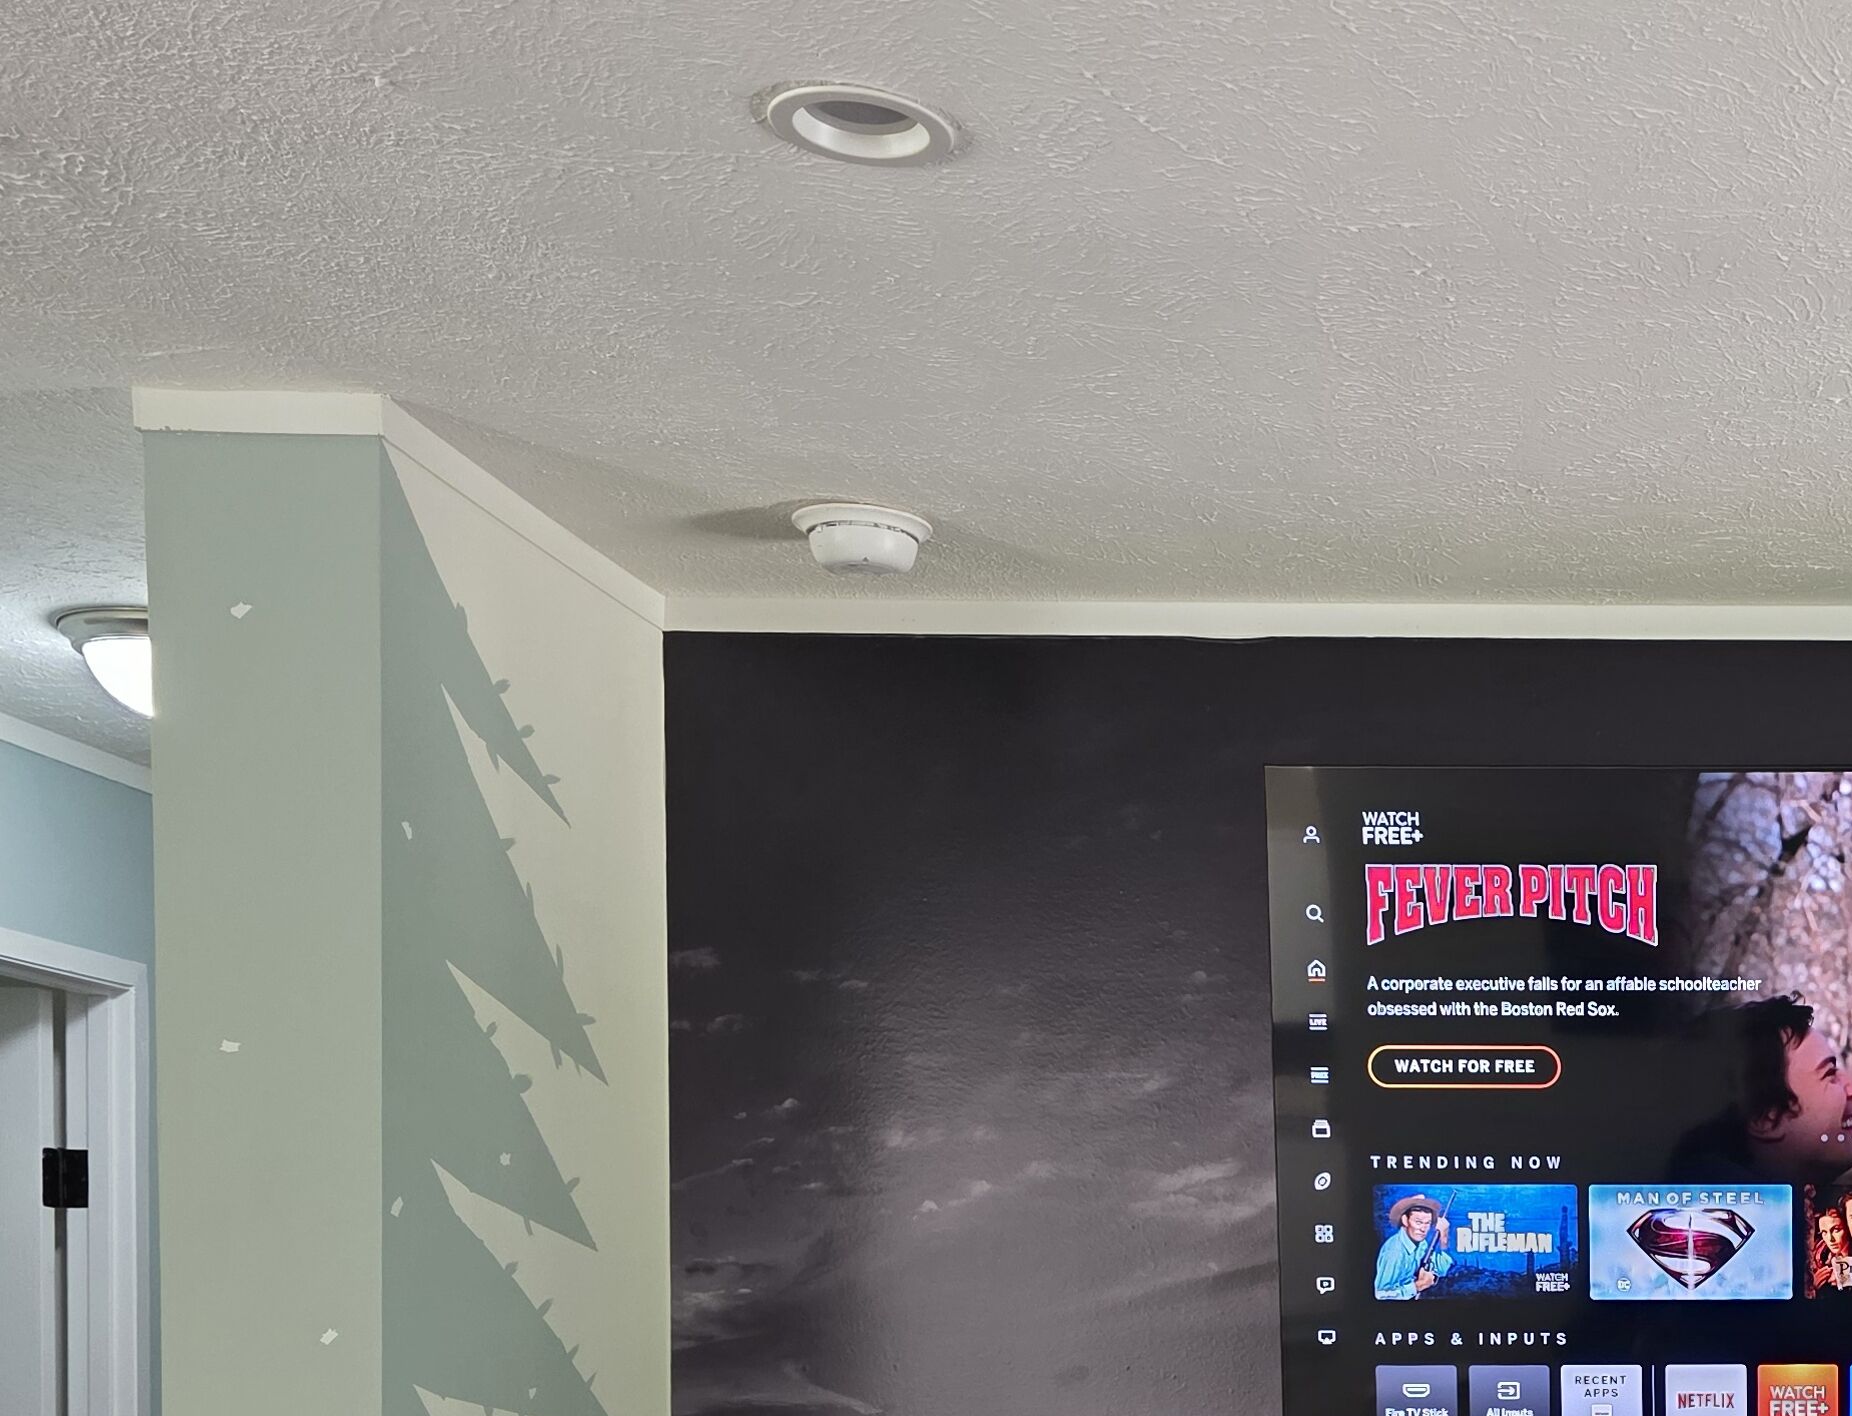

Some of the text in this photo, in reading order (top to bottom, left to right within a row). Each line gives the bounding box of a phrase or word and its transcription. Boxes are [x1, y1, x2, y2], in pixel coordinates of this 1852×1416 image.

[1362, 811, 1420, 826] WATCH
[1362, 827, 1424, 845] FREE+
[1365, 863, 1658, 946] FEVER PITCH
[1367, 976, 1761, 994] A corporate executive falls for an affable schoolteacher
[1367, 1001, 1619, 1017] obsessed with the Boston Red Sox.
[1395, 1059, 1535, 1073] WATCH FOR FREE
[1370, 1155, 1562, 1170] TRENDING NOW
[1617, 1192, 1765, 1205] MAN OF STEEL
[1469, 1213, 1505, 1231] THE
[1457, 1228, 1552, 1254] RIFLEMAN
[1536, 1273, 1568, 1282] WATCH
[1535, 1282, 1570, 1292] FREE+
[1375, 1332, 1567, 1345] APPS & INPUTS
[1575, 1376, 1626, 1385] RECENT
[1584, 1388, 1619, 1398] APPS
[1769, 1385, 1825, 1400] WATCH
[1678, 1393, 1734, 1409] NETFLIX
